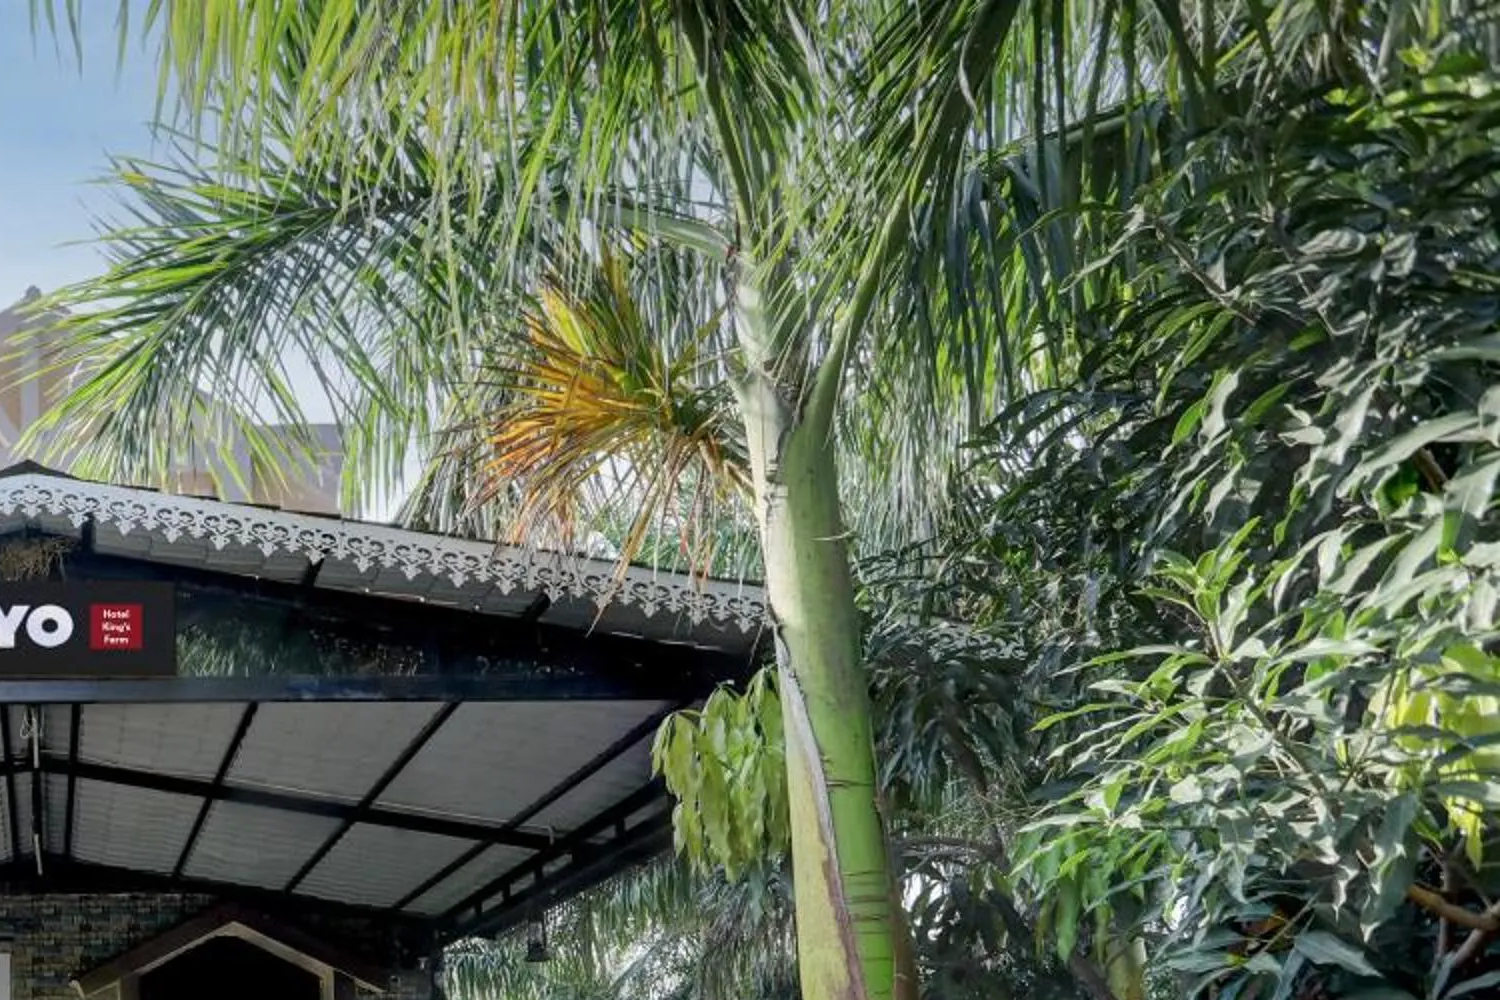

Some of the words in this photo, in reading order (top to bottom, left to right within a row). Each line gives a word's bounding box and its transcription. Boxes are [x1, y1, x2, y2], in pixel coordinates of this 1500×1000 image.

[103, 609, 130, 619] Hotel
[102, 621, 131, 633] King's
[103, 634, 129, 645] Farm
